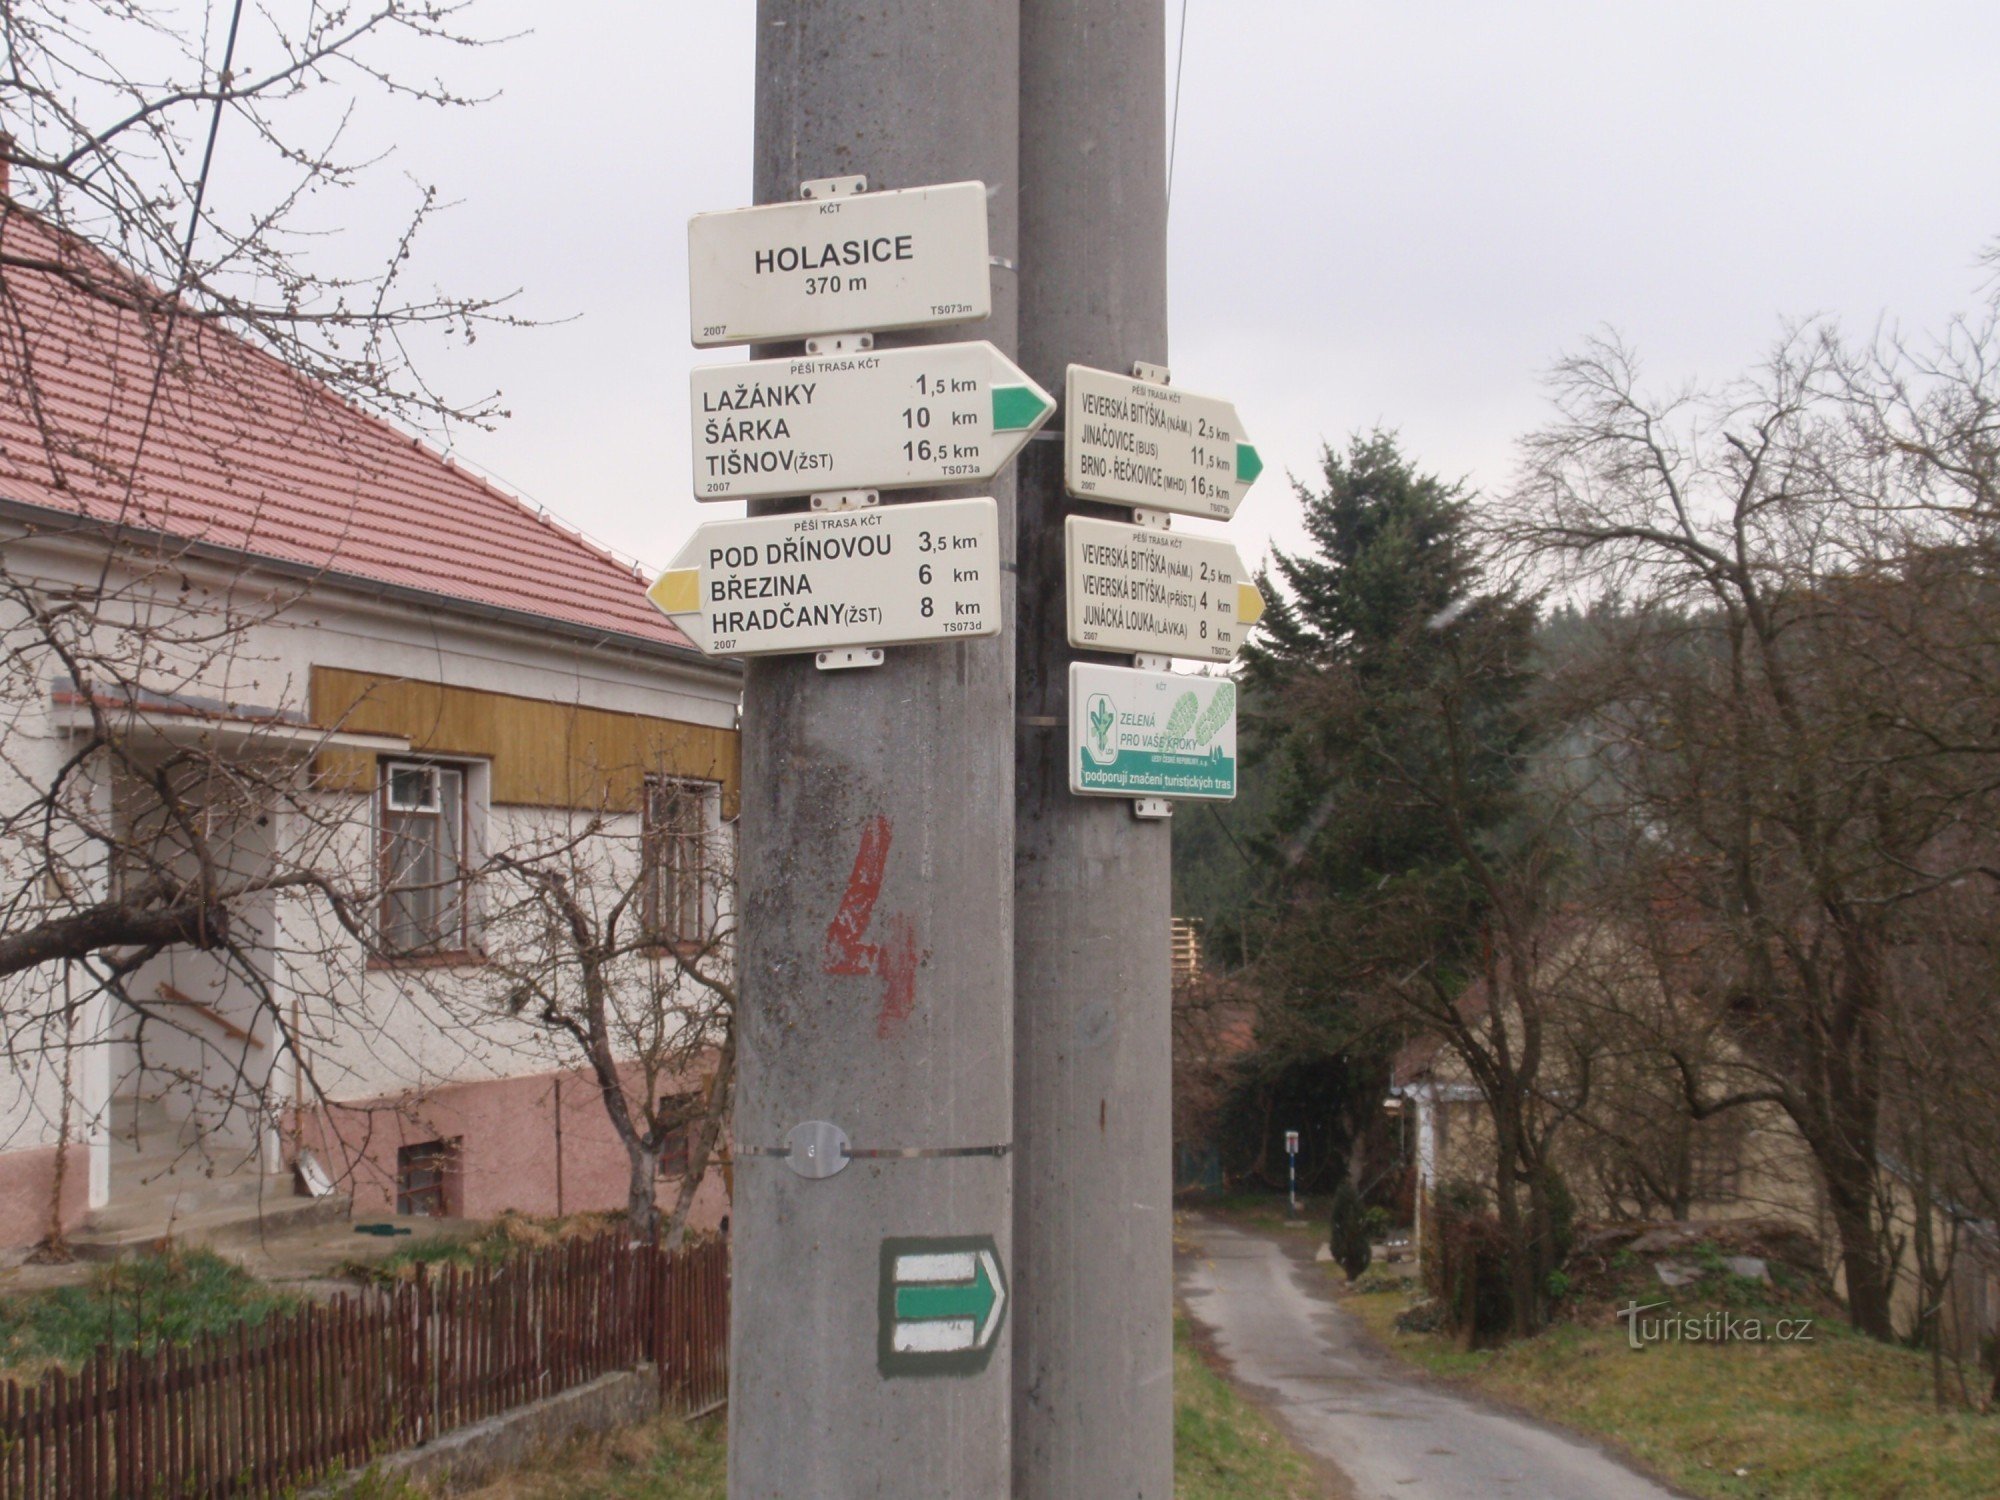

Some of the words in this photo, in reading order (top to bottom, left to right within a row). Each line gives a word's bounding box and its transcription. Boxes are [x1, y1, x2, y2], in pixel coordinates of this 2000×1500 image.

[819, 203, 841, 214] KČT
[755, 235, 913, 274] HOLASICE
[805, 276, 841, 295] 370
[849, 276, 867, 291] m
[930, 304, 972, 316] TS073m
[703, 326, 727, 336] 2007
[790, 362, 815, 375] PĚŠÍ
[818, 360, 855, 373] TRASA
[858, 358, 880, 370] KČT
[703, 383, 817, 413] LAŽÁNKY
[916, 374, 945, 398] 1,5
[951, 378, 977, 393] km
[1148, 388, 1168, 400] TRASA
[705, 417, 790, 444] ŠÁRKA
[902, 407, 931, 429] 10
[952, 411, 978, 426] km
[1082, 392, 1129, 422] VEVERSKÁ
[1198, 418, 1214, 441] 2,5
[1216, 427, 1230, 442] km
[903, 440, 947, 463] 16,5
[953, 444, 979, 459] km
[1082, 423, 1134, 453] JINAČOVICE
[1216, 456, 1230, 471] km
[941, 464, 980, 476] TS073a
[1081, 454, 1107, 478] BRNO
[1113, 455, 1162, 488] ŘEČKOVICE
[1191, 475, 1214, 499] 16,5
[1216, 485, 1230, 500] km
[707, 482, 730, 493] 2007
[794, 519, 818, 532] PĚŠÍ
[821, 517, 858, 530] TRASA
[860, 515, 882, 527] KČT
[710, 547, 758, 570] POD
[766, 534, 892, 565] DŘÍNOVOU
[918, 531, 947, 554] 3,5
[953, 535, 977, 550] km
[1149, 536, 1169, 547] TRASA
[1082, 543, 1129, 568] VEVERSKÁ
[1200, 562, 1216, 583] 2,5
[1218, 571, 1232, 585] km
[711, 574, 812, 601] BŘEZINA
[918, 564, 933, 585] 6
[953, 568, 979, 583] km
[1083, 574, 1129, 600] VEVERSKÁ
[1200, 591, 1208, 610] 4
[1218, 600, 1231, 613] km
[920, 597, 934, 618] 8
[955, 601, 980, 616] km
[943, 621, 982, 633] TS073d
[1084, 603, 1124, 630] JUNÁCKÁ
[1200, 620, 1207, 639] 8
[1218, 629, 1231, 642] km
[714, 639, 737, 650] 2007
[1120, 712, 1155, 727] ZELENÁ
[1120, 733, 1139, 746] PRO
[1142, 734, 1165, 748] VAŠE
[1167, 736, 1198, 750] KROKY
[1085, 769, 1128, 786] podporují
[1130, 772, 1163, 785] značení
[1165, 775, 1213, 790] turistických
[1215, 778, 1231, 789] tras
